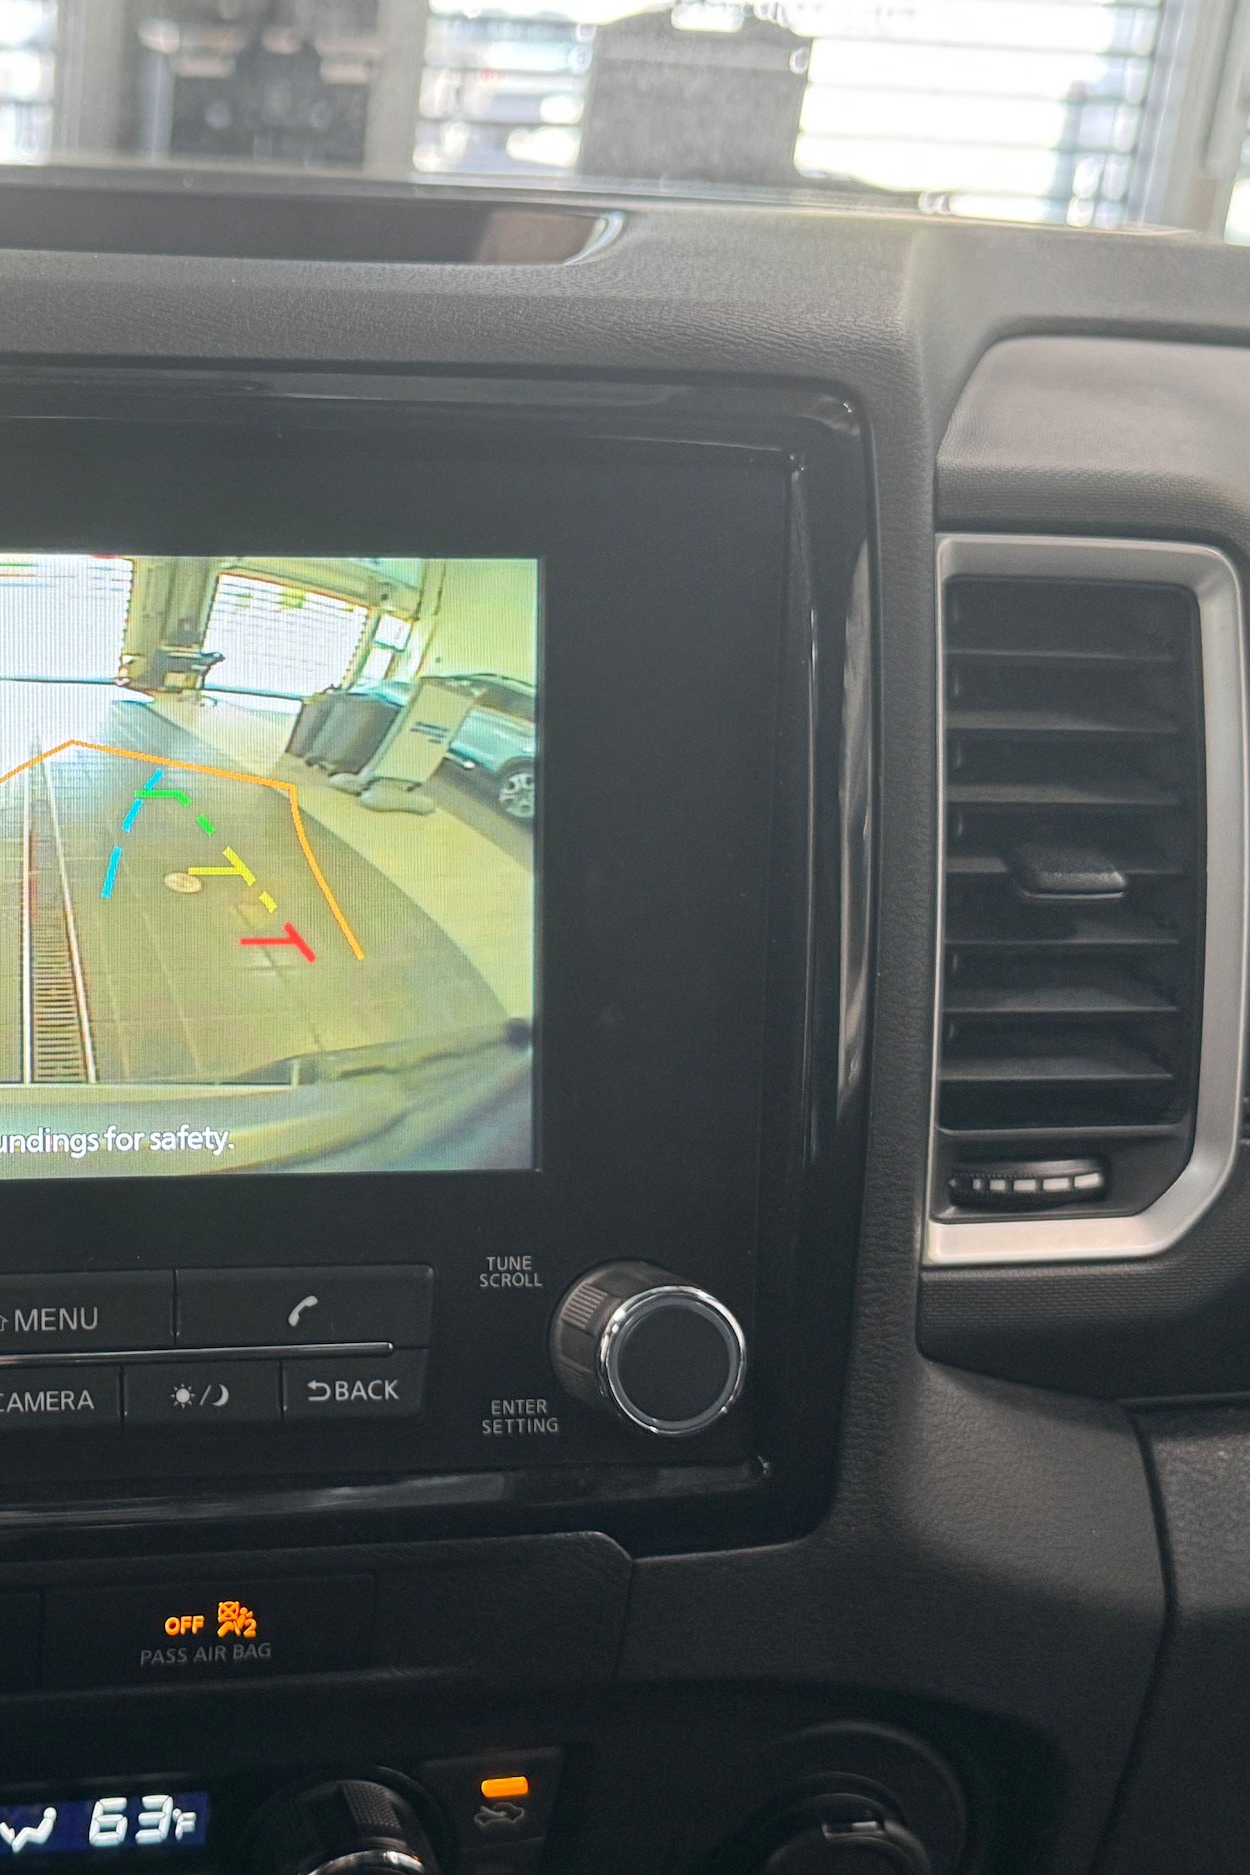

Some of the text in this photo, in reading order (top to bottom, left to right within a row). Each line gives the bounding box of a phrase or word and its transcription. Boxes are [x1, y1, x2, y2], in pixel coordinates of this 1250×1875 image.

[104, 1125, 145, 1151] for
[150, 1124, 234, 1156] safety.
[486, 1255, 532, 1272] TUNE
[479, 1271, 543, 1288] SCROLL
[14, 1307, 98, 1332] MENU
[335, 1379, 399, 1401] BACK
[491, 1398, 548, 1416] ENTER
[481, 1417, 559, 1435] SETTING
[164, 1615, 205, 1636] OFF
[140, 1642, 272, 1666] PASS AIR BAG
